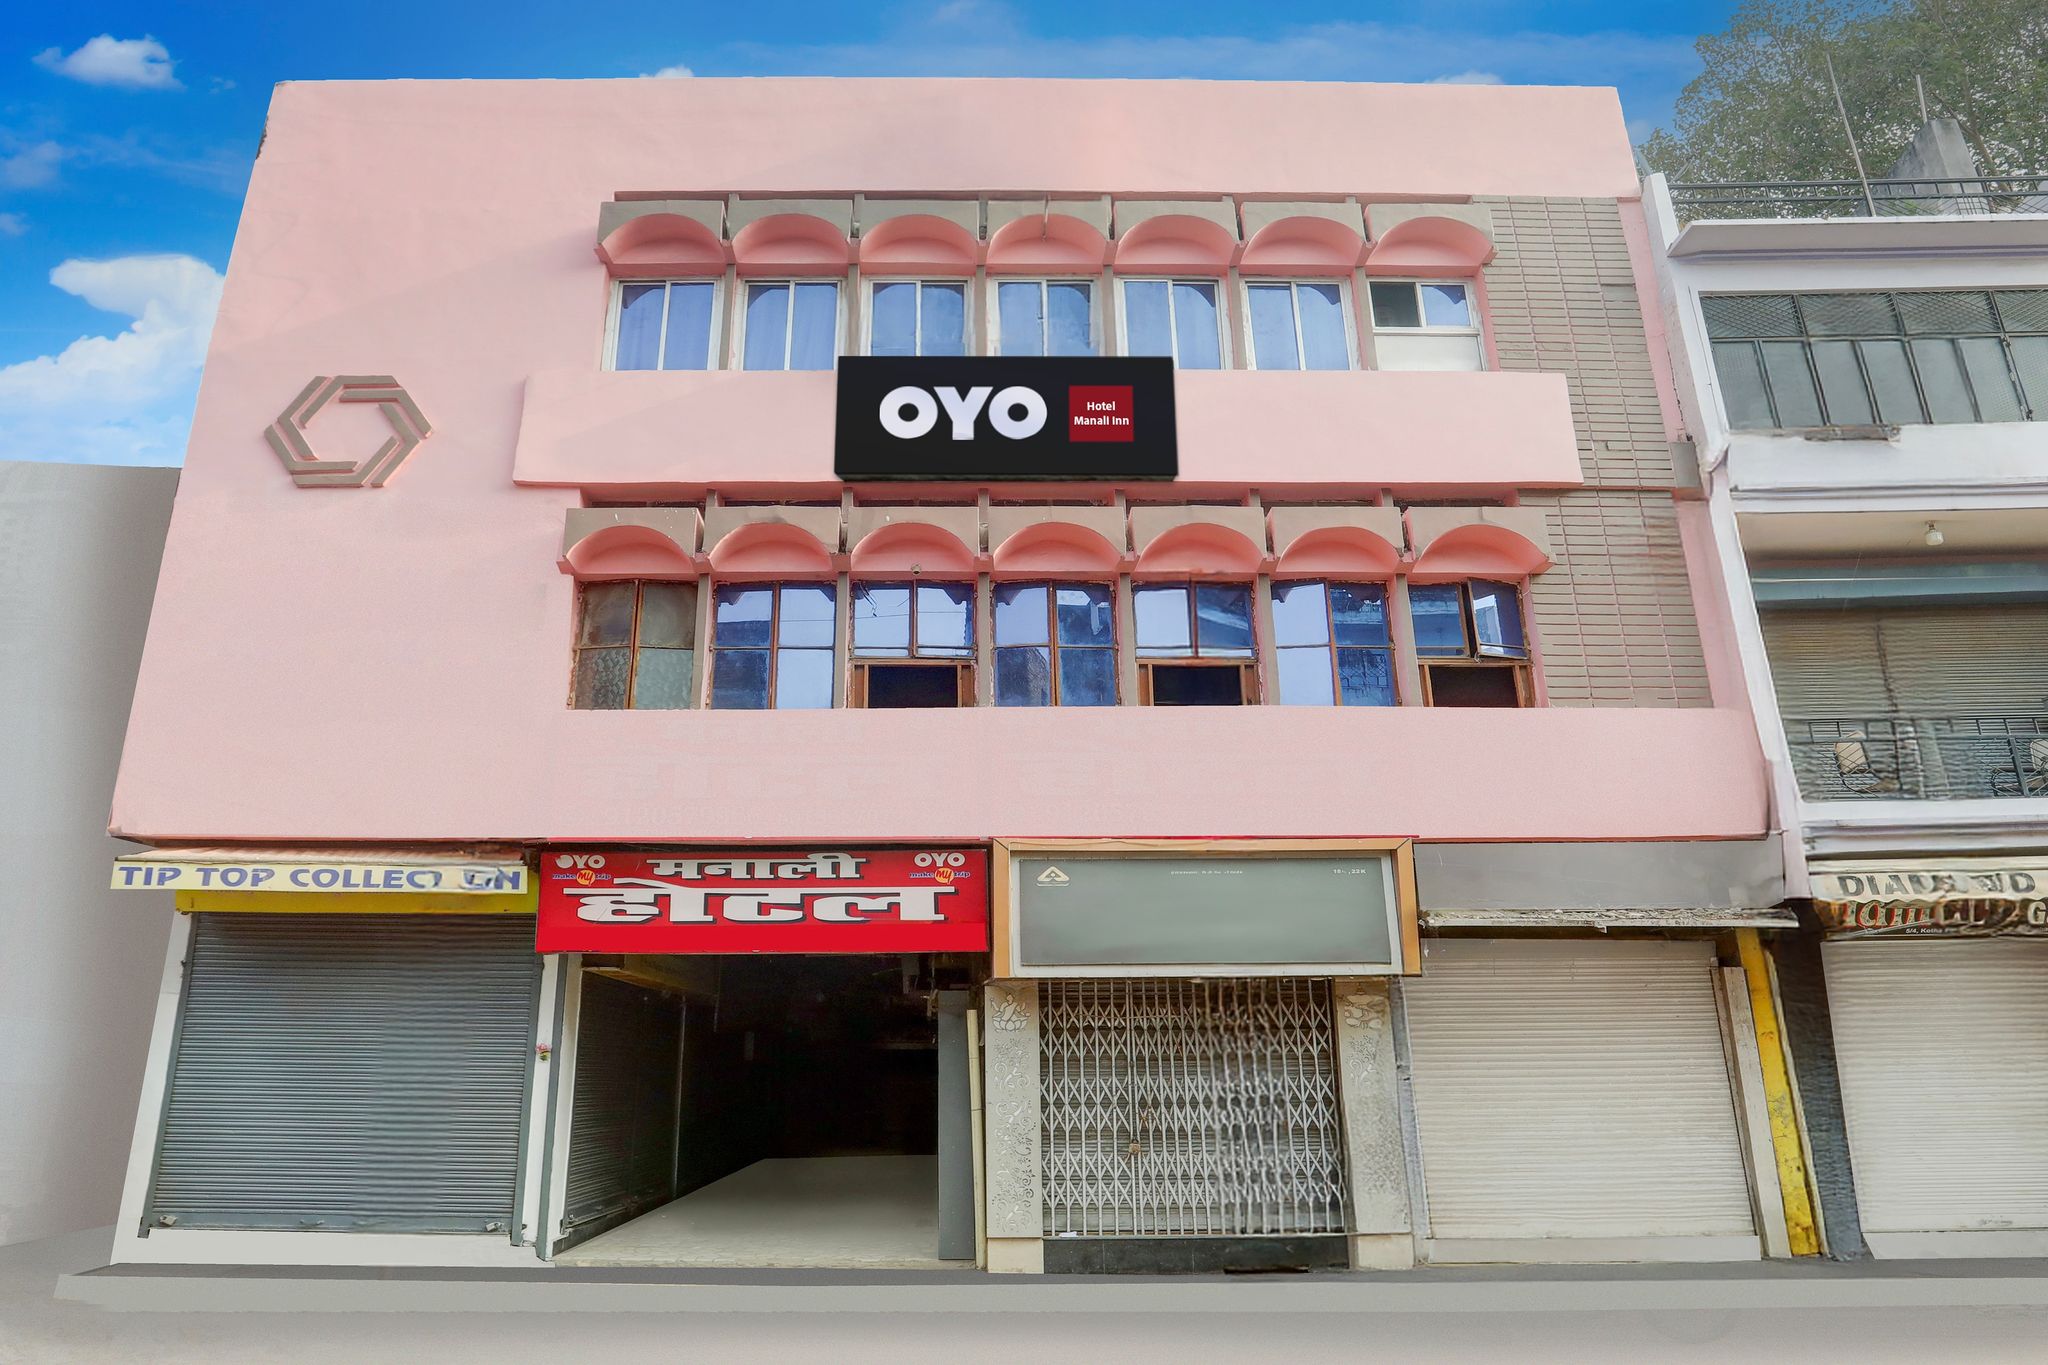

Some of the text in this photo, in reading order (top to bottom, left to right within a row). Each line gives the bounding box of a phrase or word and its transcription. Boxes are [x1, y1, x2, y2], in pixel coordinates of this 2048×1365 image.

[879, 385, 1048, 441] OYO
[1087, 401, 1116, 411] Hotel
[1112, 416, 1130, 426] Inn
[555, 854, 606, 869] OYO
[646, 852, 868, 880] मनाली
[914, 852, 966, 867] OYO
[118, 866, 182, 886] TIP
[196, 867, 275, 888] TOP
[562, 877, 956, 922] होटल
